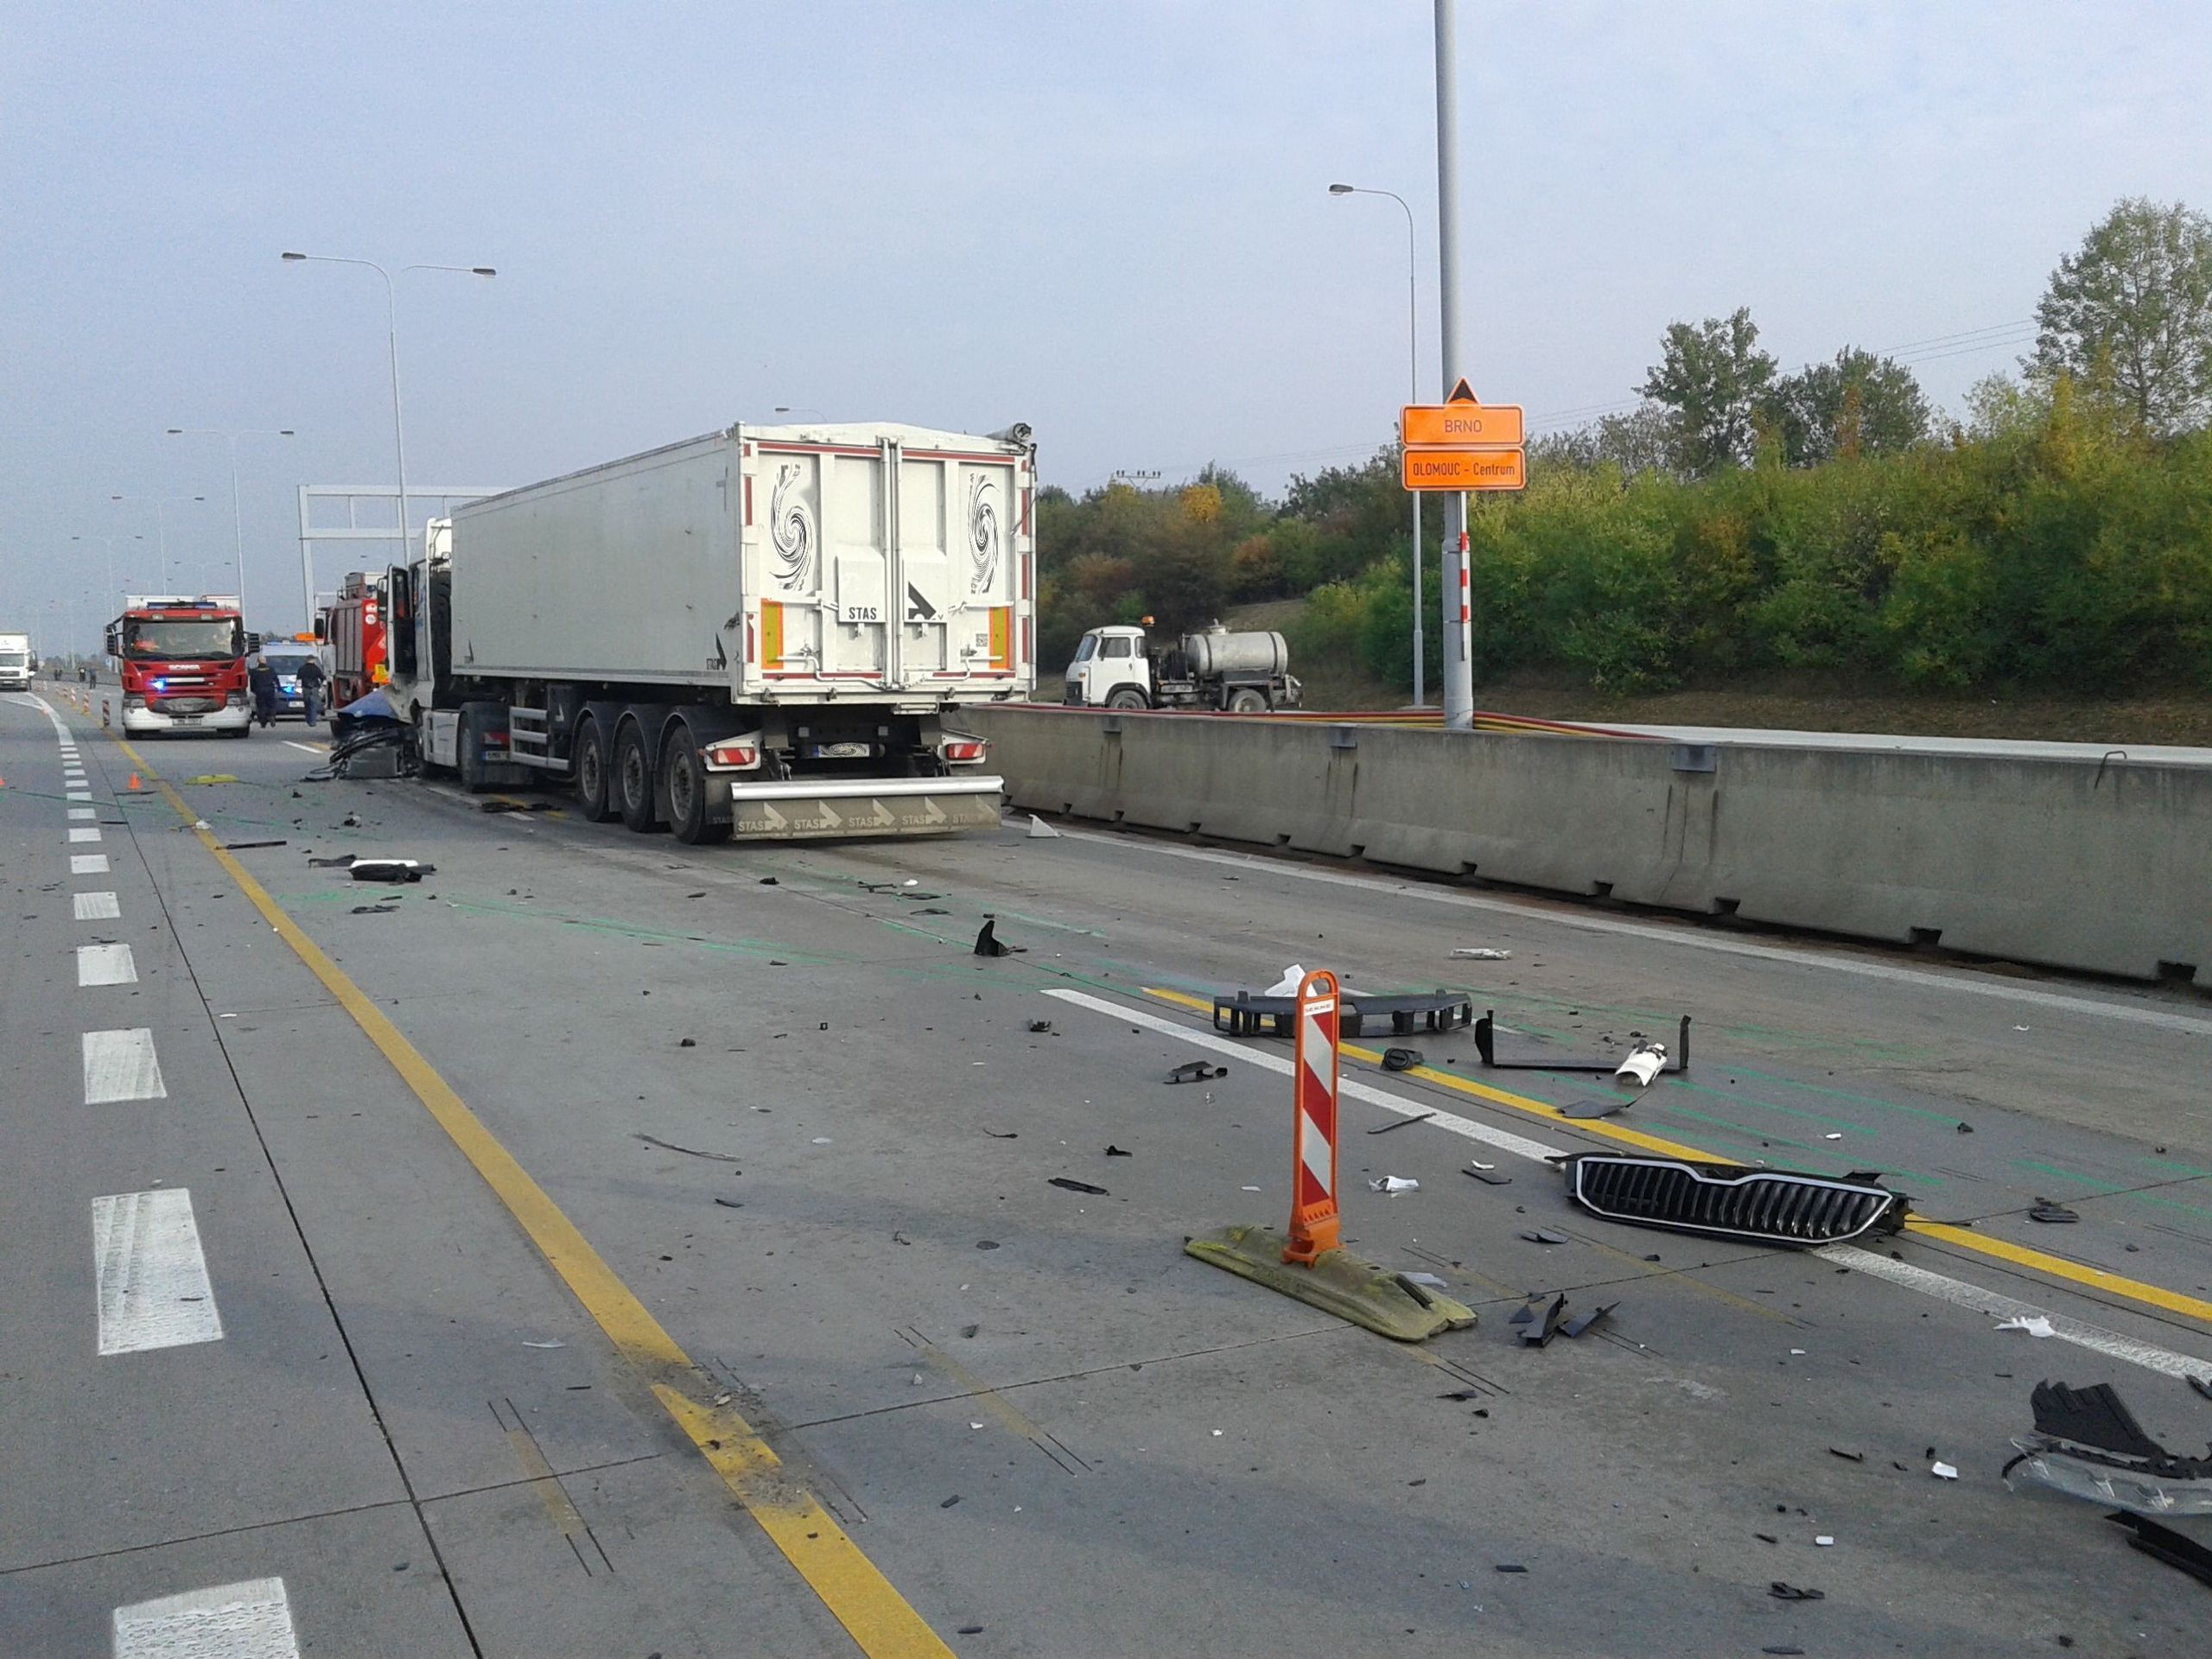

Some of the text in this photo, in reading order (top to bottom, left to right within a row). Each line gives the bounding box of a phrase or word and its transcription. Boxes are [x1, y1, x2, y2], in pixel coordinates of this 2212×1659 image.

[1444, 419, 1483, 433] BRNO
[1413, 462, 1460, 476] OLOMOUC
[1473, 462, 1515, 476] Centrum
[849, 607, 877, 620] STAS
[738, 820, 764, 831] STAS
[794, 819, 820, 830] STAS
[849, 817, 874, 827] STAS
[902, 815, 926, 824] STAS
